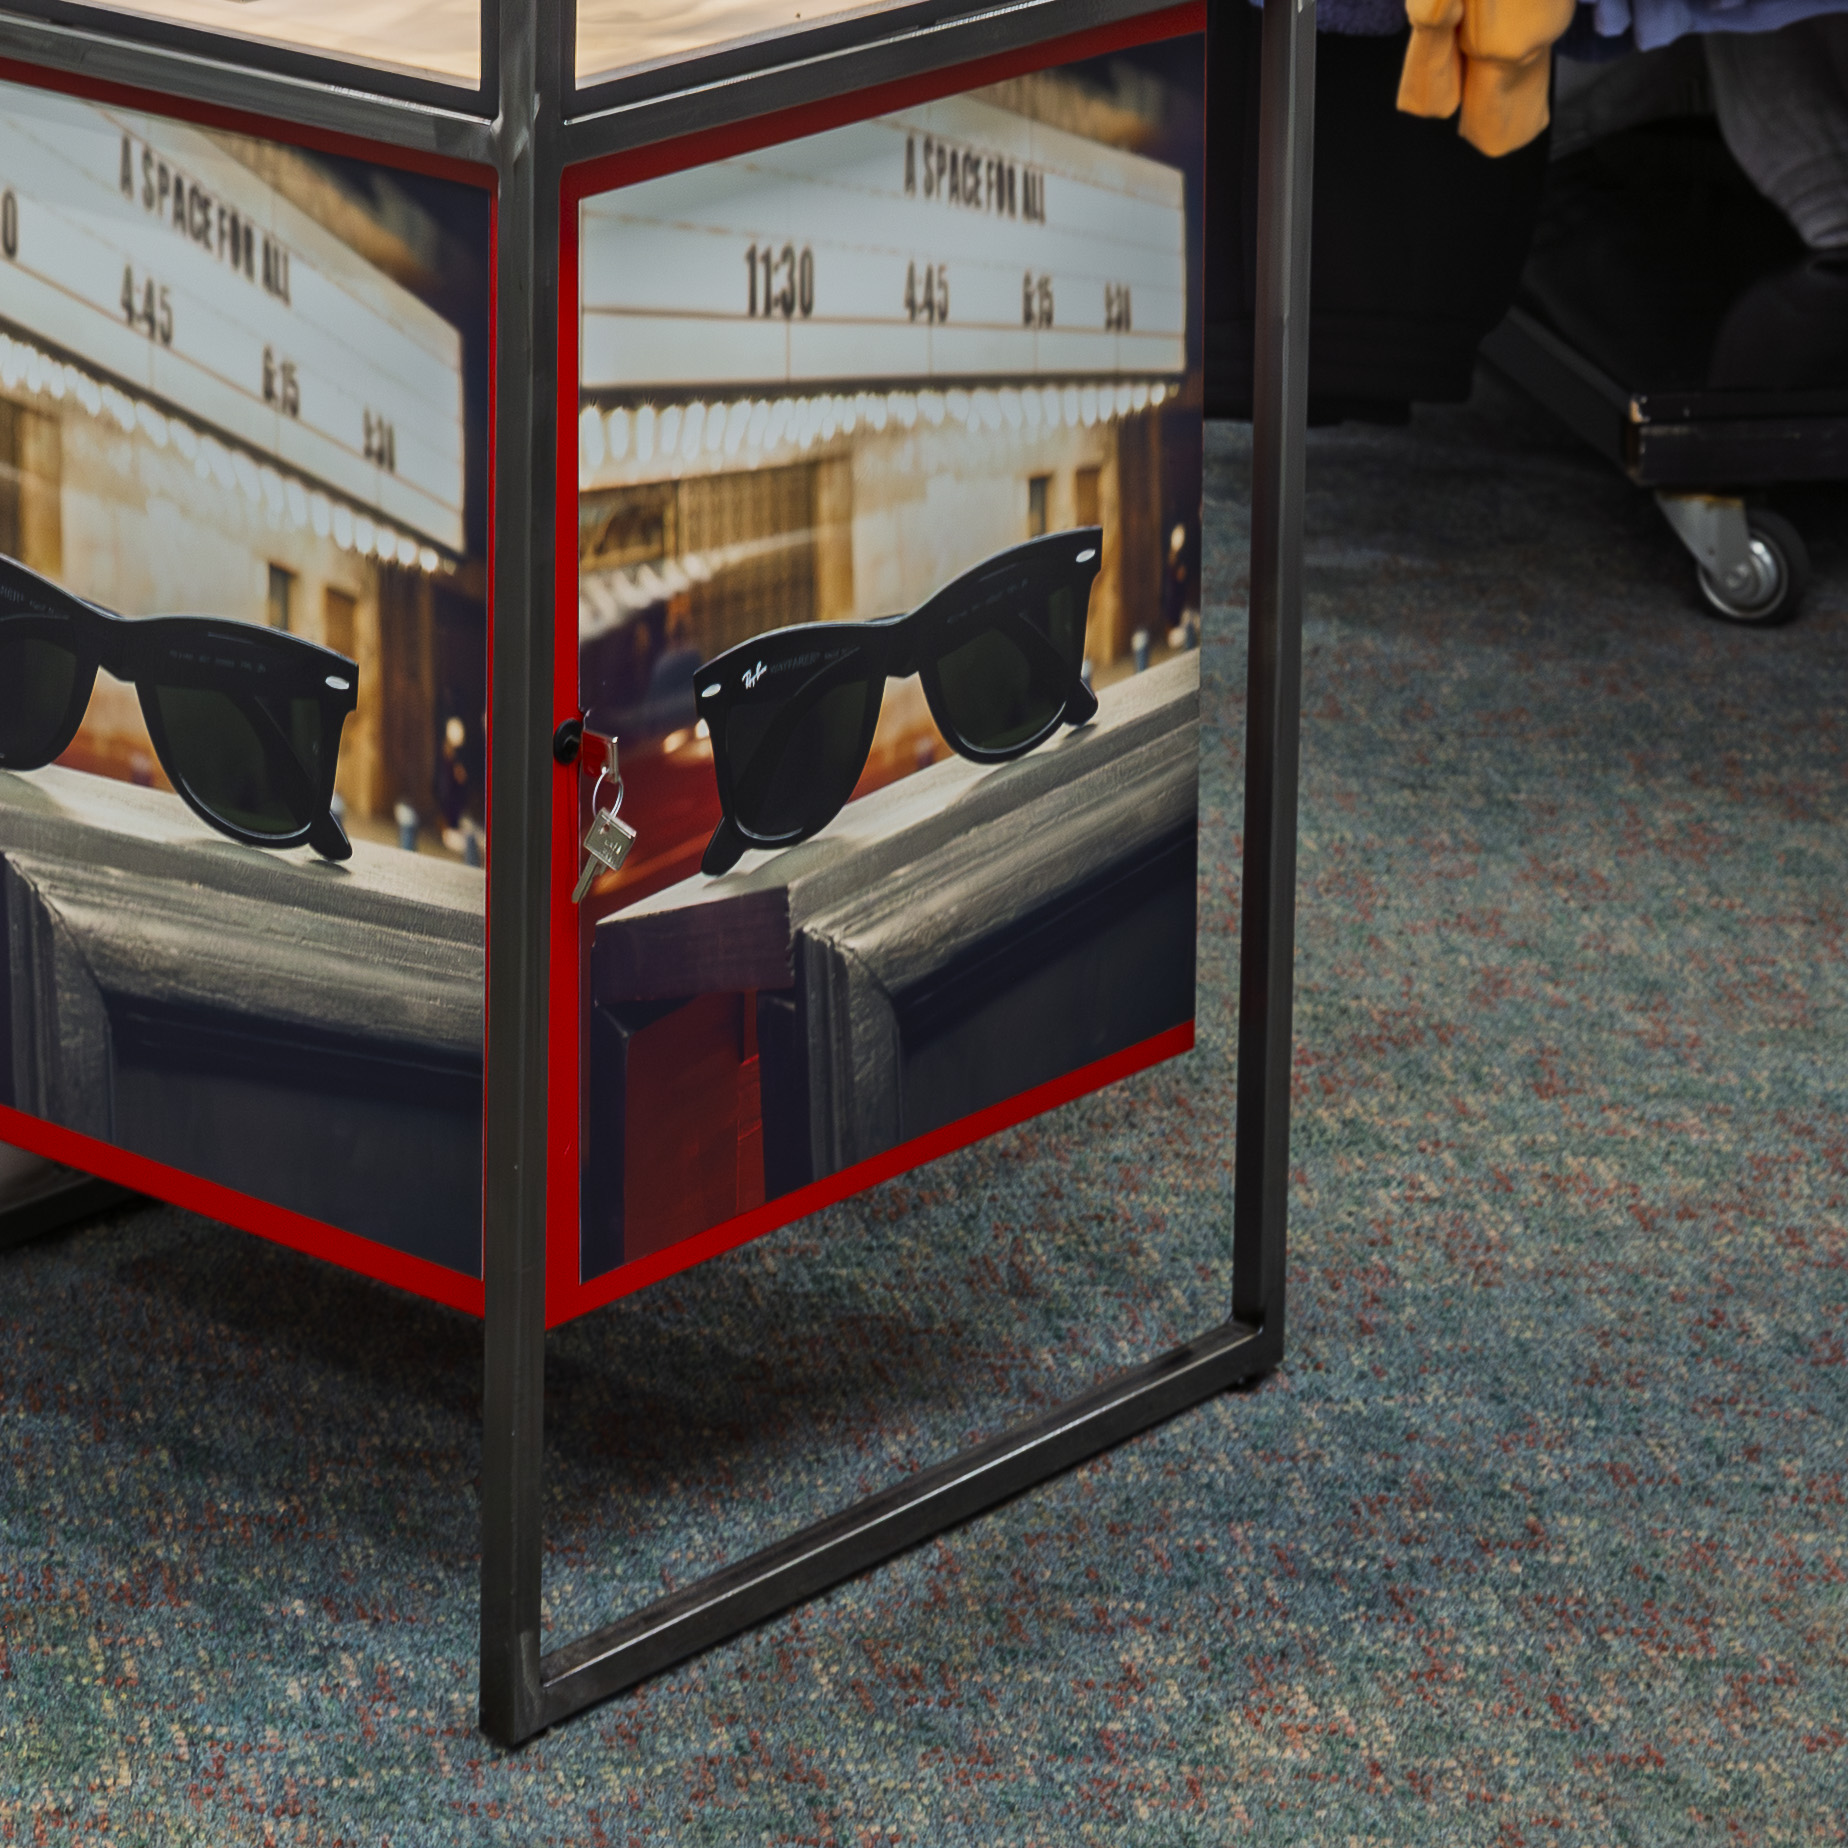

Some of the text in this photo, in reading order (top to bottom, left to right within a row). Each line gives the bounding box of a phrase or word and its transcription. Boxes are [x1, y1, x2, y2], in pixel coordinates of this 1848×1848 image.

[120, 134, 291, 308] A SPACE FOR ALL
[904, 133, 1046, 227] A SPACE FOR ALL
[120, 261, 173, 348] 4:45
[744, 243, 815, 320] 11:30
[904, 259, 950, 326] 4:45
